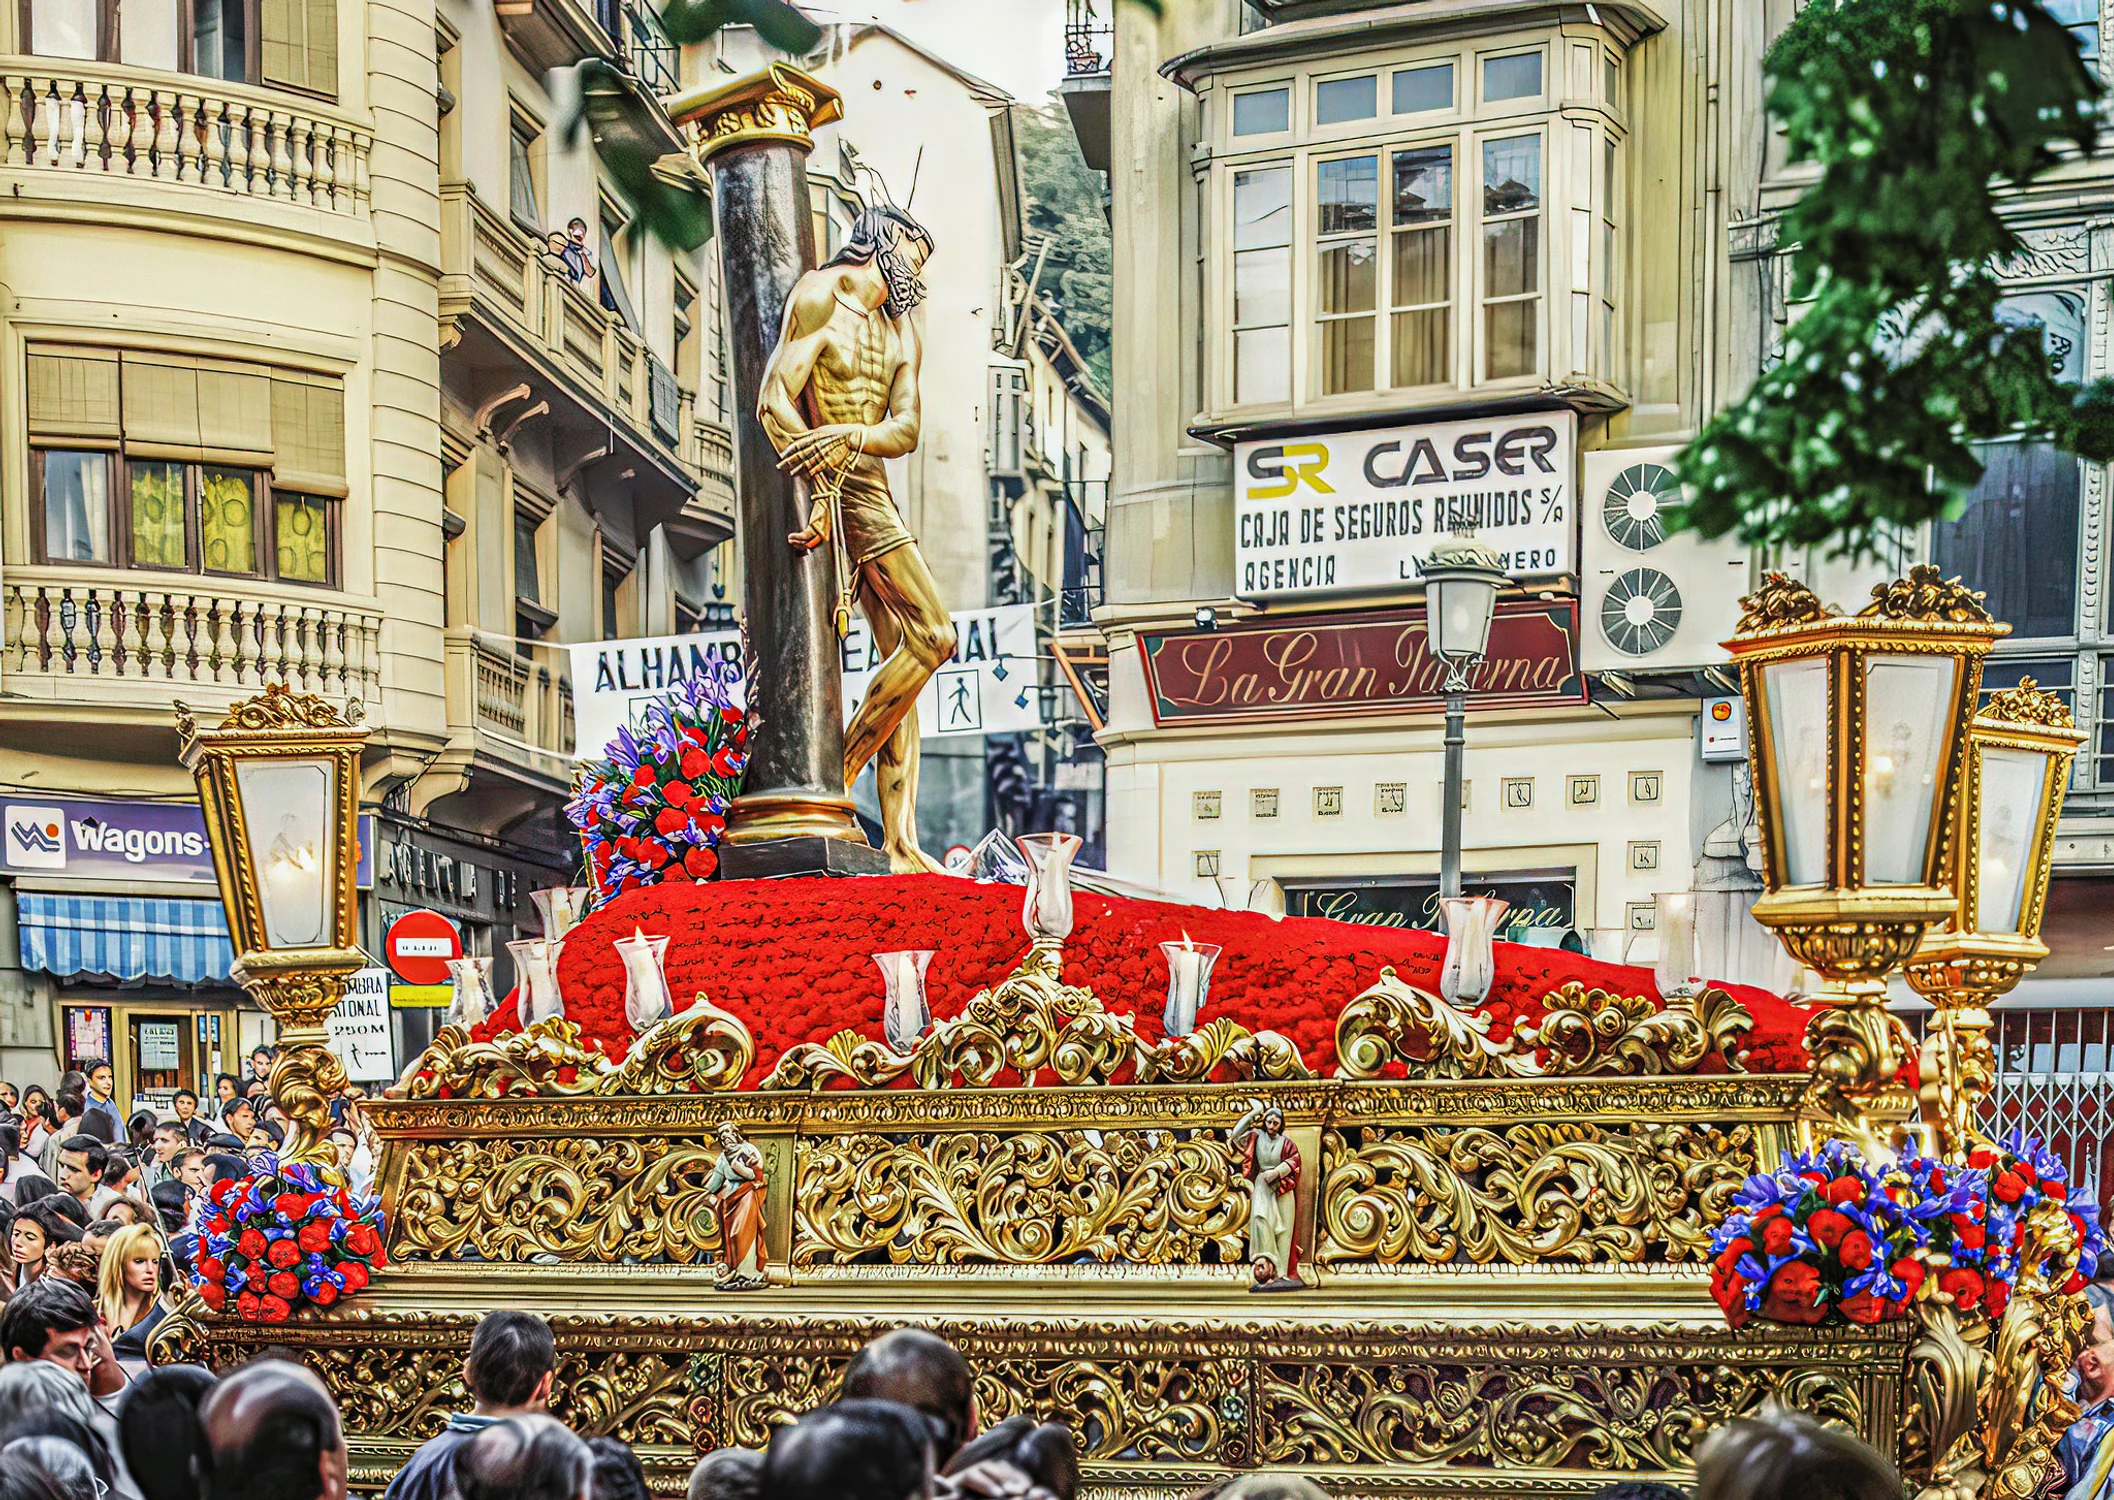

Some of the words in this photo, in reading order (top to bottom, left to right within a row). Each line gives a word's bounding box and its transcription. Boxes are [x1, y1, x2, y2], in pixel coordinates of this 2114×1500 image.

[1362, 425, 1558, 489] CASER
[1240, 509, 1290, 549] CAJA
[1300, 506, 1325, 544] DE
[1334, 499, 1423, 542] SEGUROS
[1244, 554, 1336, 592] AGENCIA
[594, 640, 744, 694] ALHAMB
[1177, 637, 1264, 706] La
[1264, 631, 1381, 702] Gran
